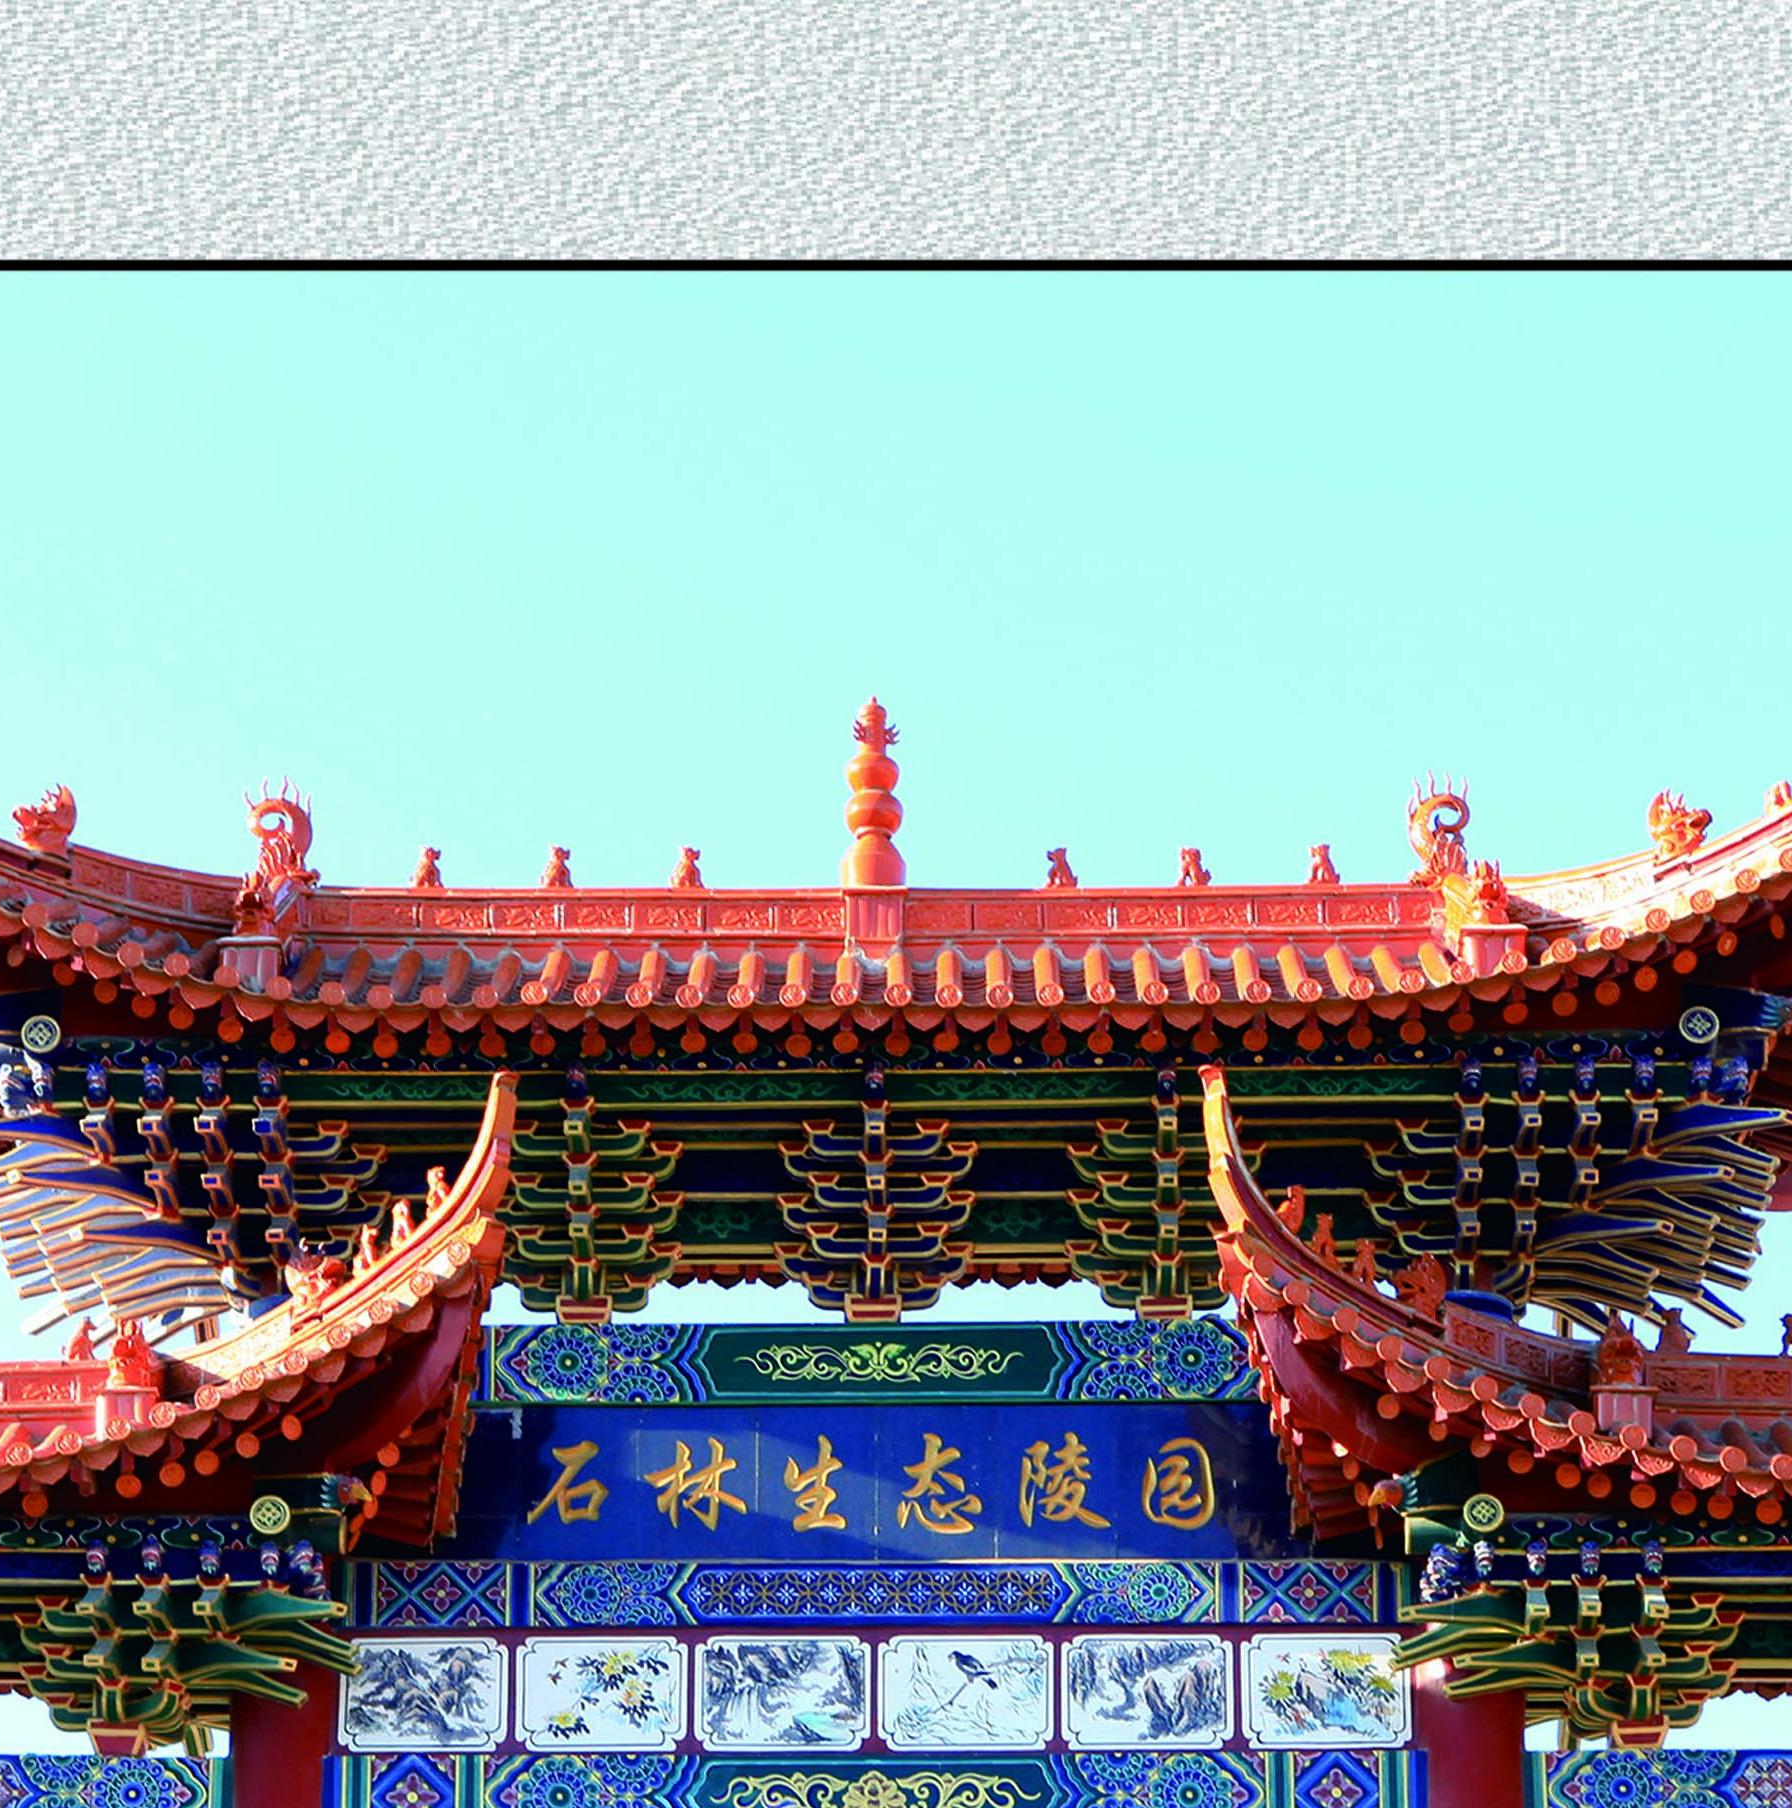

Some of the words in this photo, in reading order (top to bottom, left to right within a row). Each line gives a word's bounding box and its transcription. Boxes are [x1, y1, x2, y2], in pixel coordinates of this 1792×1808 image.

[527, 1431, 1216, 1534] 石林生态陵园
